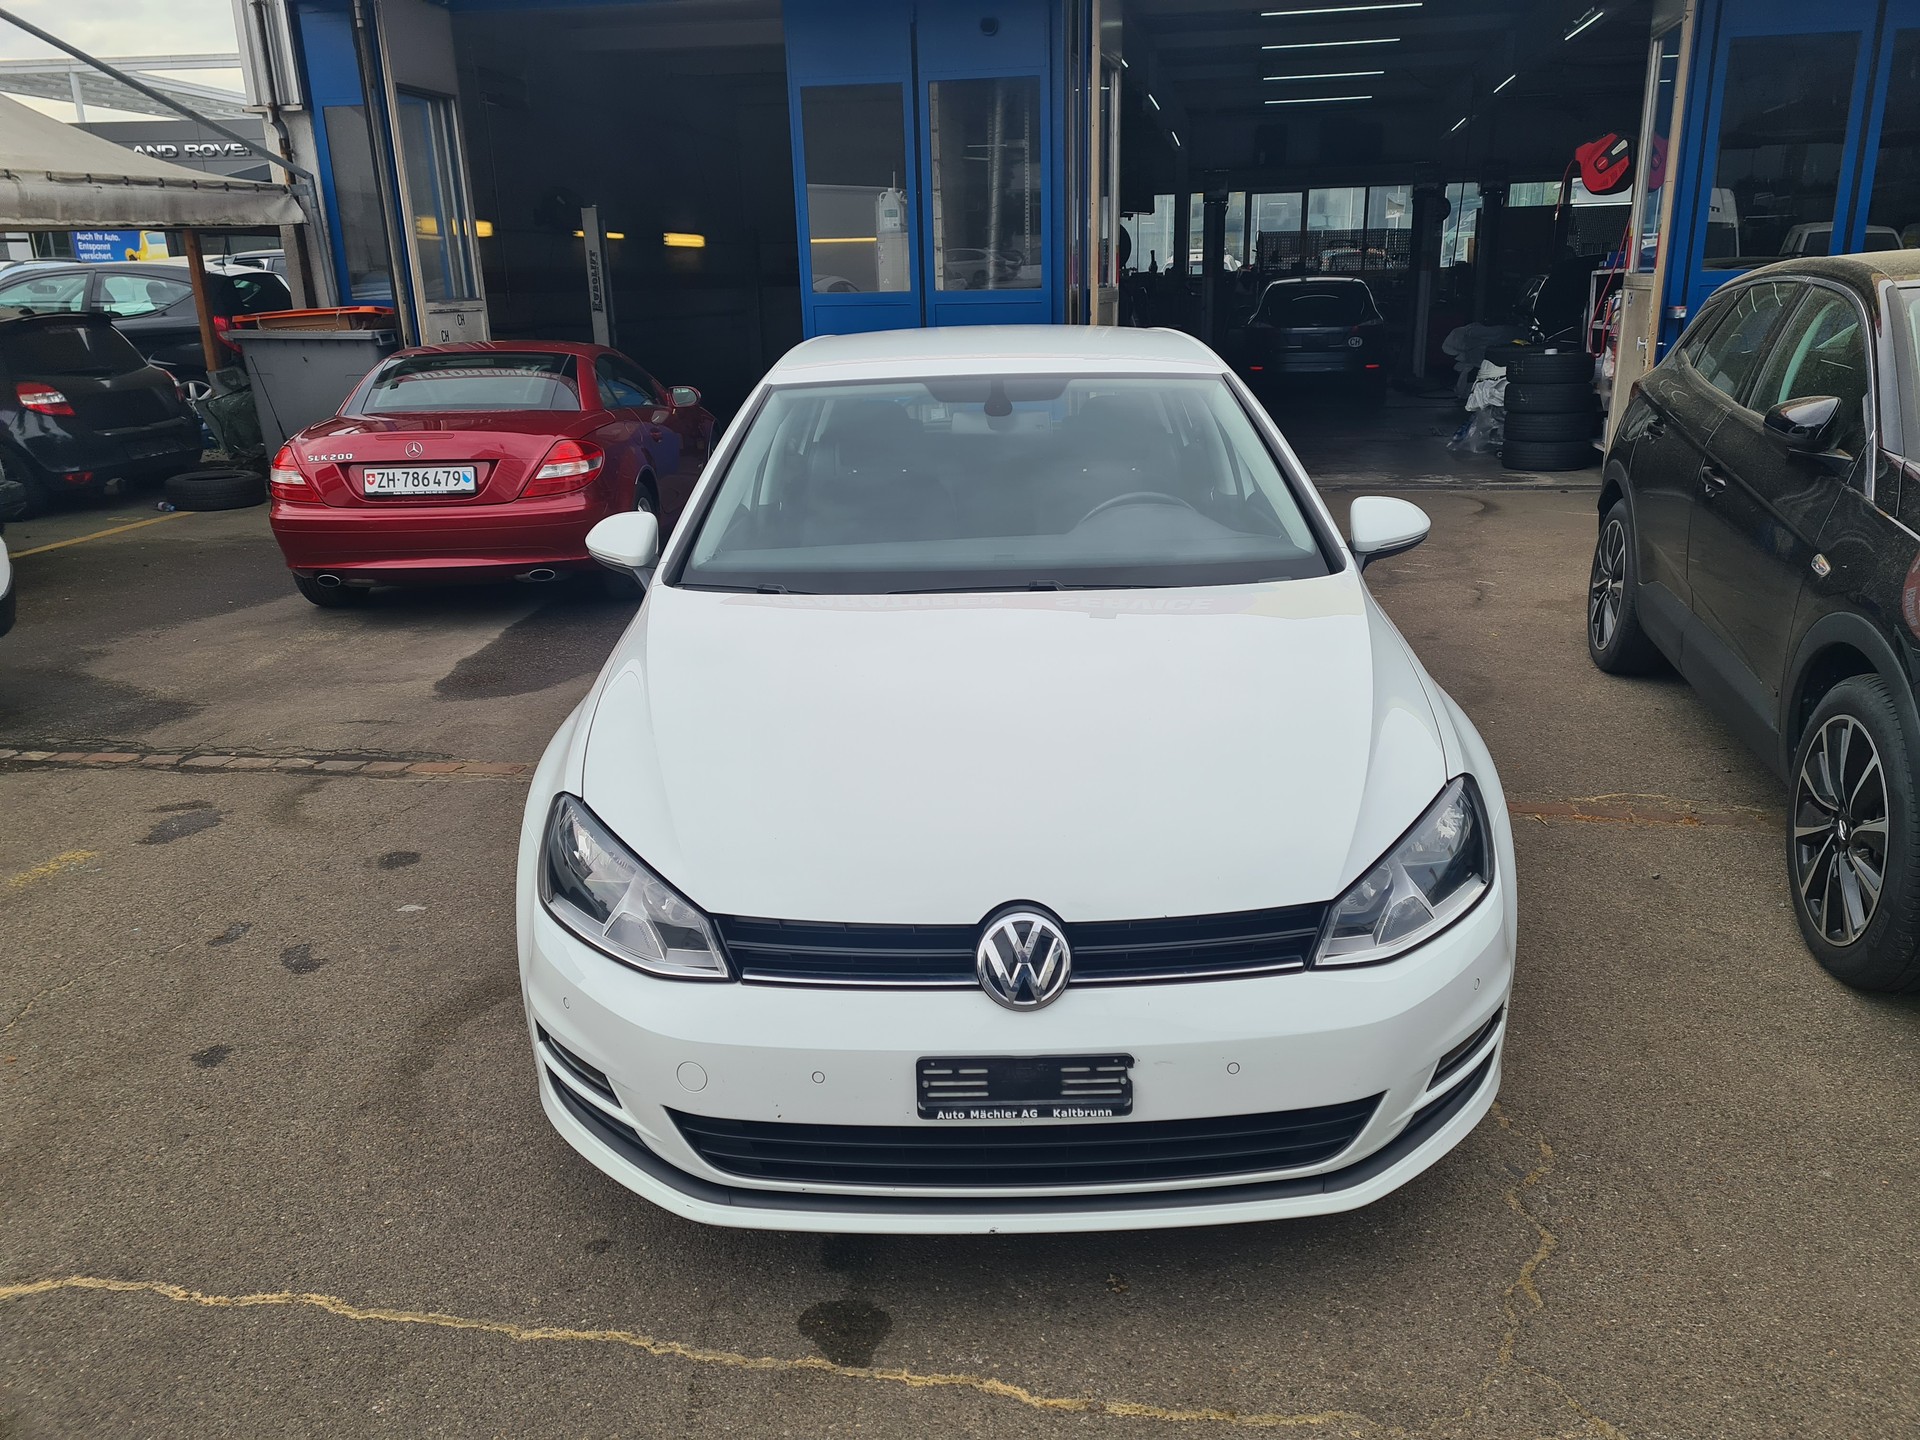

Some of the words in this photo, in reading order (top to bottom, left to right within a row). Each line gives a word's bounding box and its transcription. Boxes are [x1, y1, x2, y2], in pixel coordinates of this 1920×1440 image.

[133, 144, 178, 158] AND
[184, 143, 252, 157] ROVE
[77, 232, 94, 241] Auch
[94, 232, 103, 241] Ihr
[104, 233, 120, 241] Auto.
[78, 242, 111, 253] Entspannt
[80, 252, 114, 260] versichert.
[456, 314, 466, 326] CH
[440, 329, 450, 343] CH
[937, 1111, 965, 1120] Auto
[970, 1109, 1018, 1119] Mächler
[1021, 1109, 1038, 1119] AG
[1052, 1108, 1113, 1118] Kaltbrunn
